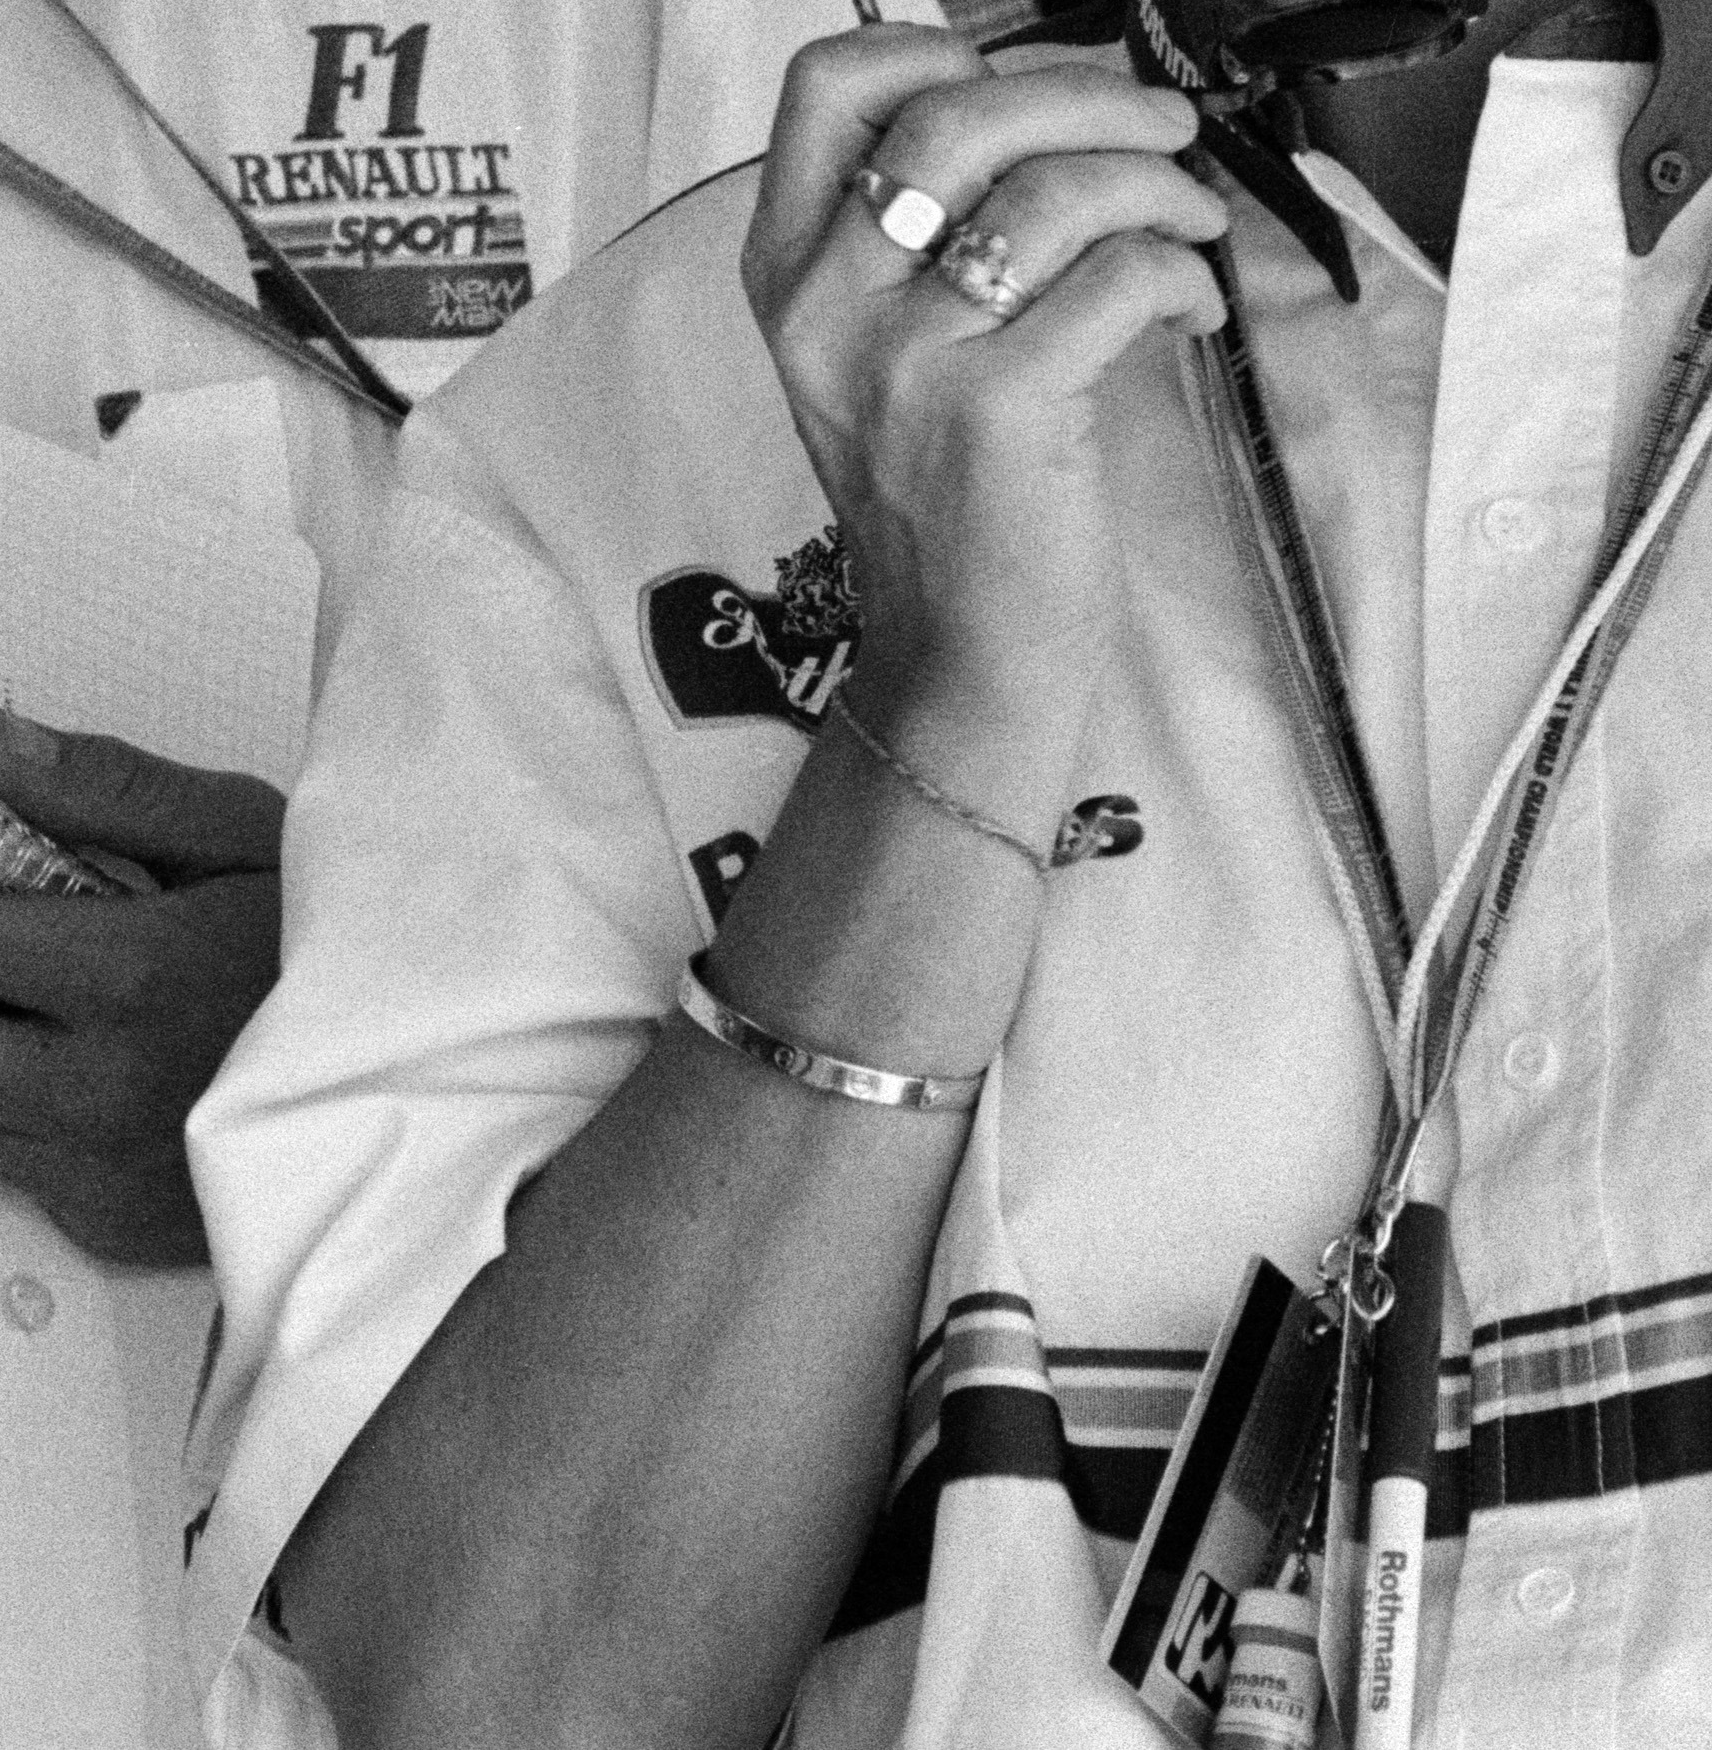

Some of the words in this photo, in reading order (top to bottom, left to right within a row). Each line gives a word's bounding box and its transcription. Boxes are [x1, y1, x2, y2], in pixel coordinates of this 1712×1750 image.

[291, 22, 431, 142] F1
[229, 144, 513, 206] RENAULT
[333, 204, 496, 269] sport
[1533, 715, 1570, 778] WORLD
[1493, 779, 1549, 914] CHAMPIONSHIP
[1370, 1549, 1408, 1712] Rothmans
